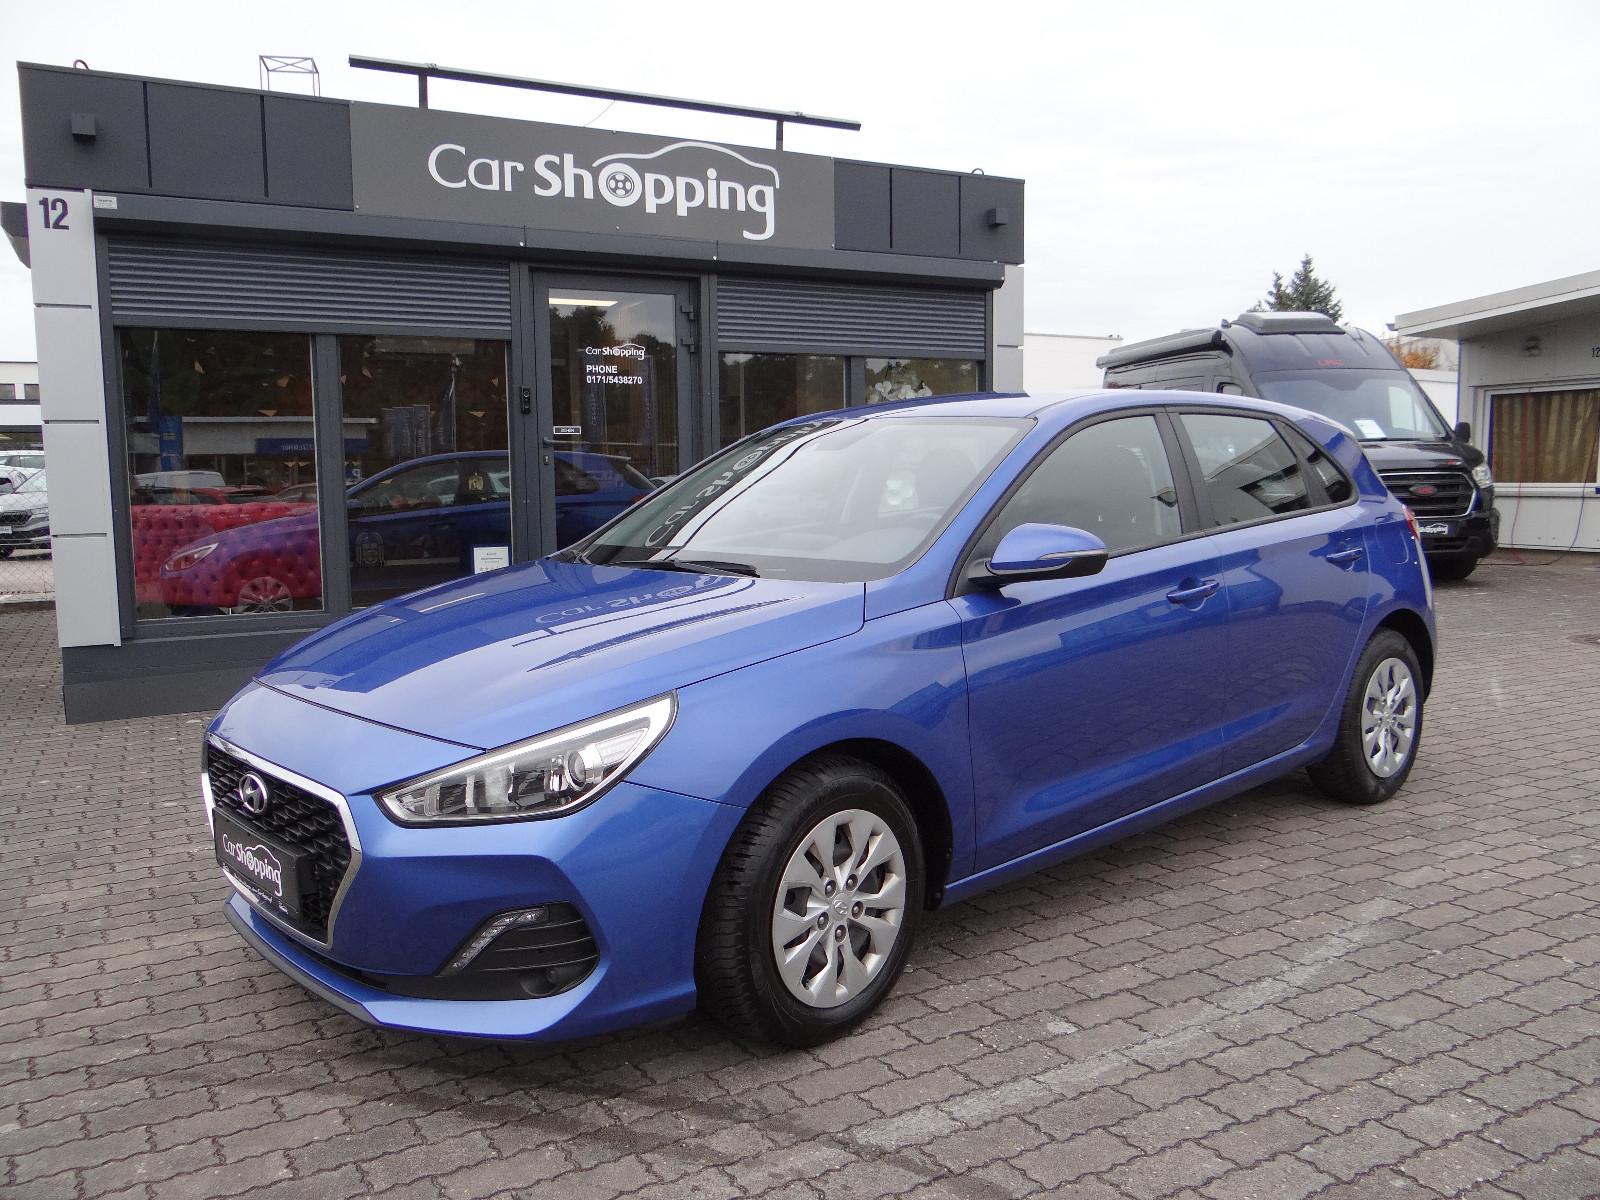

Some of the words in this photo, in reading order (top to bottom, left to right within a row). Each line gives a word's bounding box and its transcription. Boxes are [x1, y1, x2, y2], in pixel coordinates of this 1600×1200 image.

[428, 143, 524, 192] Car
[533, 150, 777, 241] Shopping
[38, 197, 70, 230] 12
[585, 346, 601, 355] Car
[602, 345, 645, 361] Shopping
[586, 365, 618, 374] PHONE
[586, 375, 643, 385] 0171/5438270
[222, 833, 235, 857] Car
[236, 843, 283, 897] Shopping
